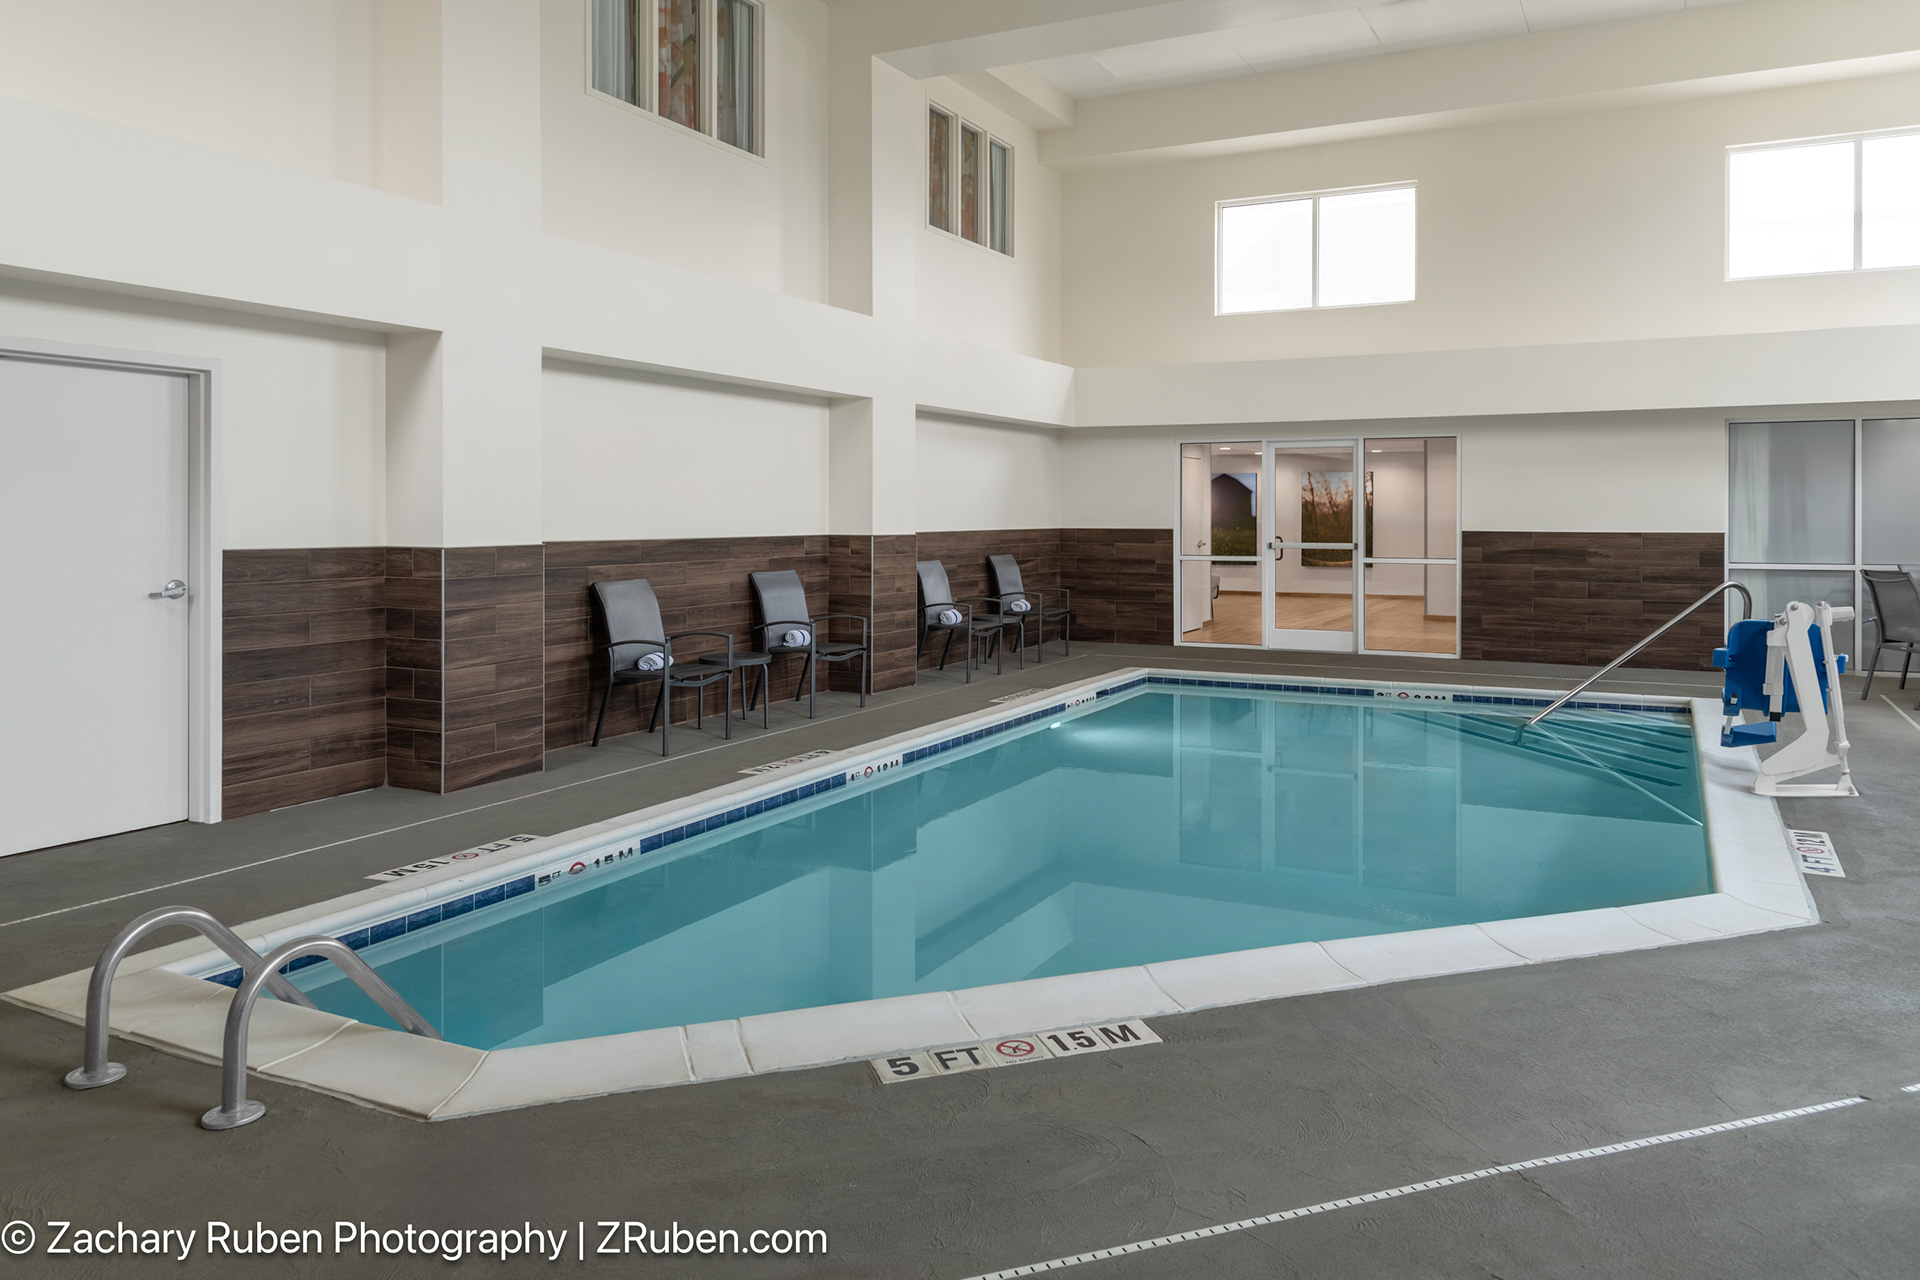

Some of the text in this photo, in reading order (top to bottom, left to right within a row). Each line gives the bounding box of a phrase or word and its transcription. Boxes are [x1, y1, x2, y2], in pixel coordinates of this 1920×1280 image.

[477, 843, 512, 853] FT
[886, 1024, 1142, 1076] 5 FT 1.5 M
